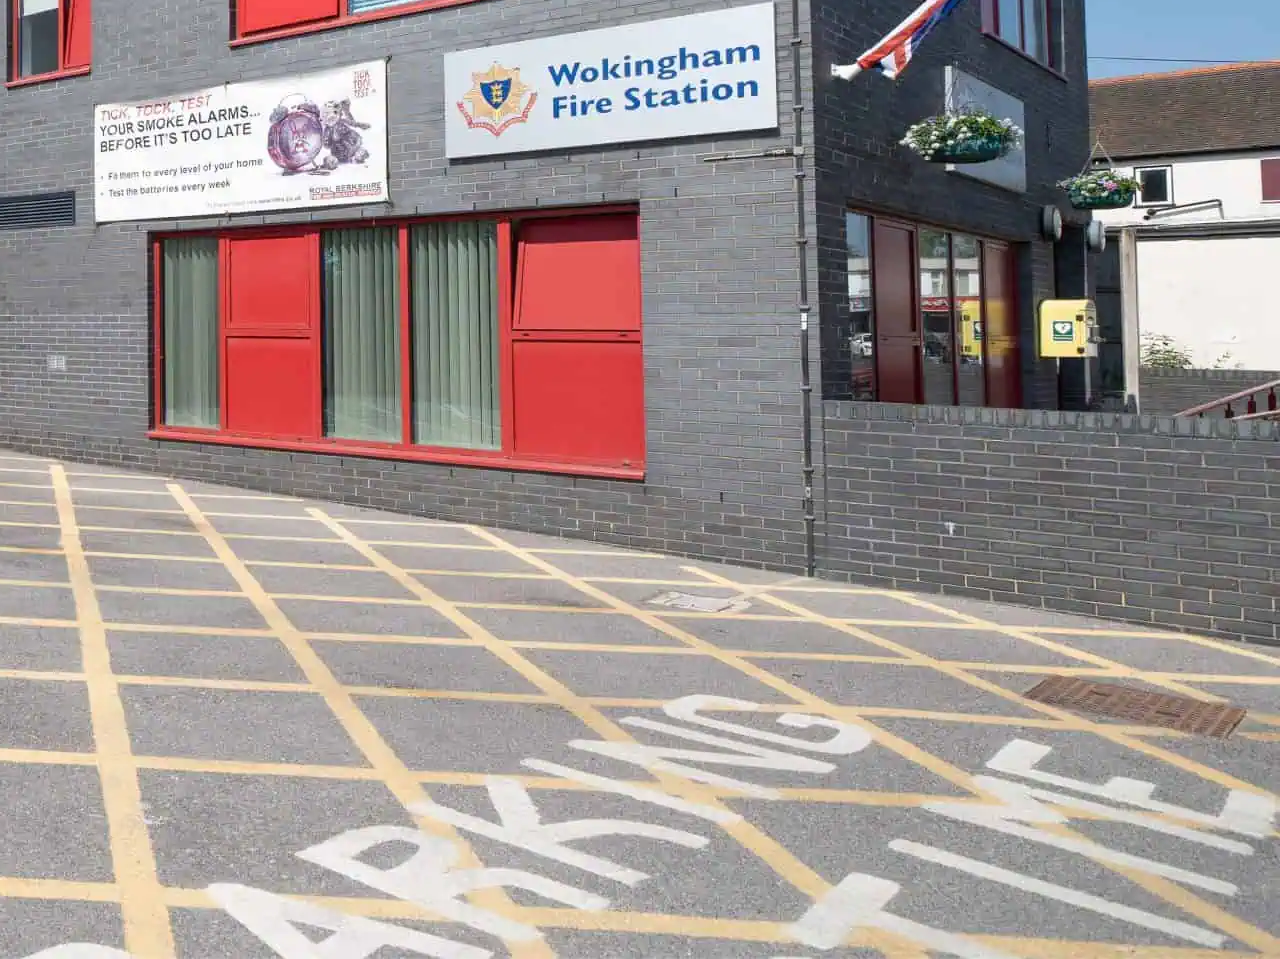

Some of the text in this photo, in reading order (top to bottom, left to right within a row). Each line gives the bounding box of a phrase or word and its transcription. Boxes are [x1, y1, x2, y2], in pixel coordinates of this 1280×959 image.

[548, 43, 761, 88] Wokingham
[179, 94, 213, 110] TEST
[552, 78, 759, 119] Fire Station
[100, 105, 261, 137] YOUR SMOKE ALARMS...
[100, 122, 252, 152] BEFORE IT'S TOO LATE
[142, 168, 152, 179] to
[154, 167, 178, 177] every
[180, 164, 201, 174] level
[203, 162, 212, 172] of
[214, 160, 234, 173] your
[237, 158, 263, 168] home
[108, 176, 231, 197] Test the batteries every week
